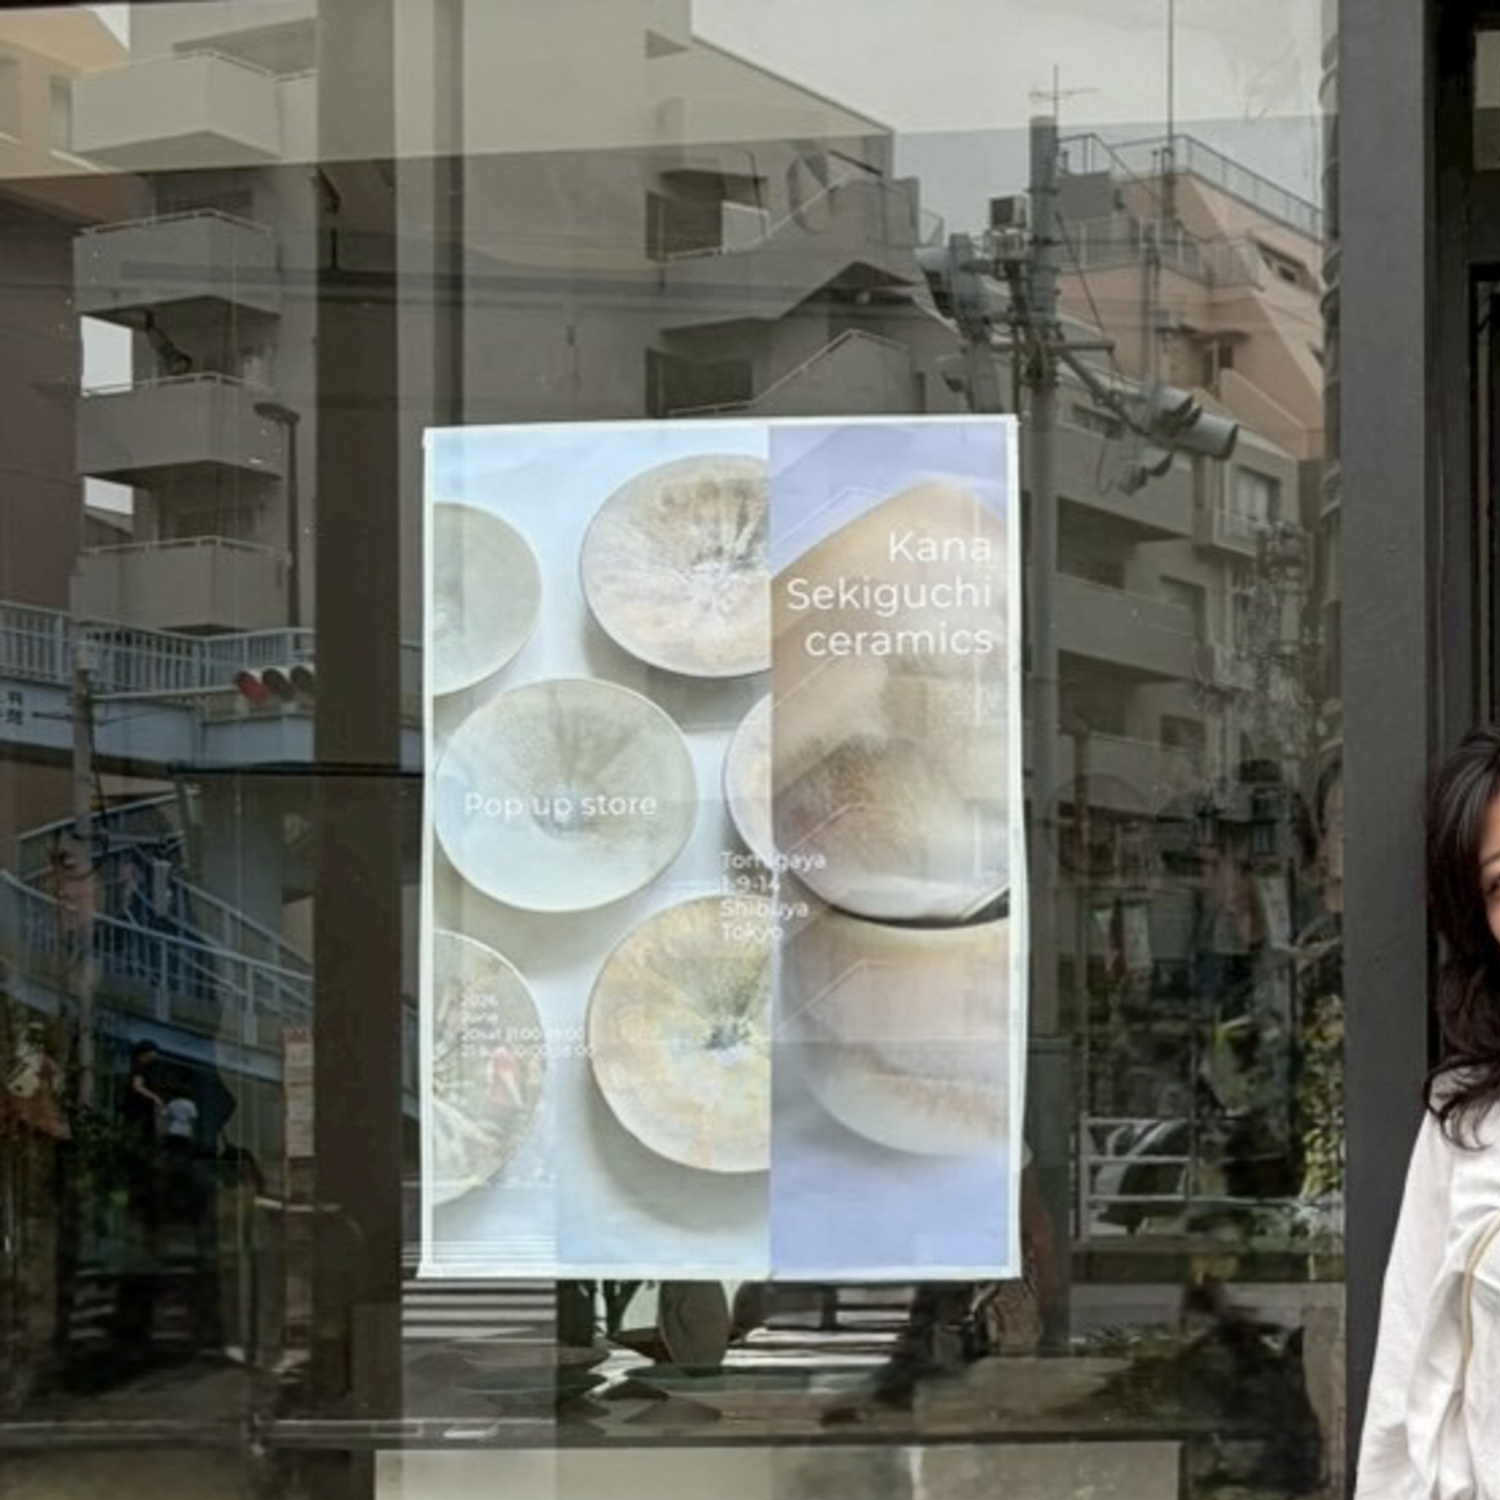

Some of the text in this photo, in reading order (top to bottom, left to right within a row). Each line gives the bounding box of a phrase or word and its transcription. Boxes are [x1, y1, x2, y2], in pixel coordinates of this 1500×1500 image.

[889, 531, 992, 563] Kana
[786, 574, 992, 618] Sekiguchi
[804, 621, 994, 657] ceramics
[465, 792, 657, 823] Pop up store
